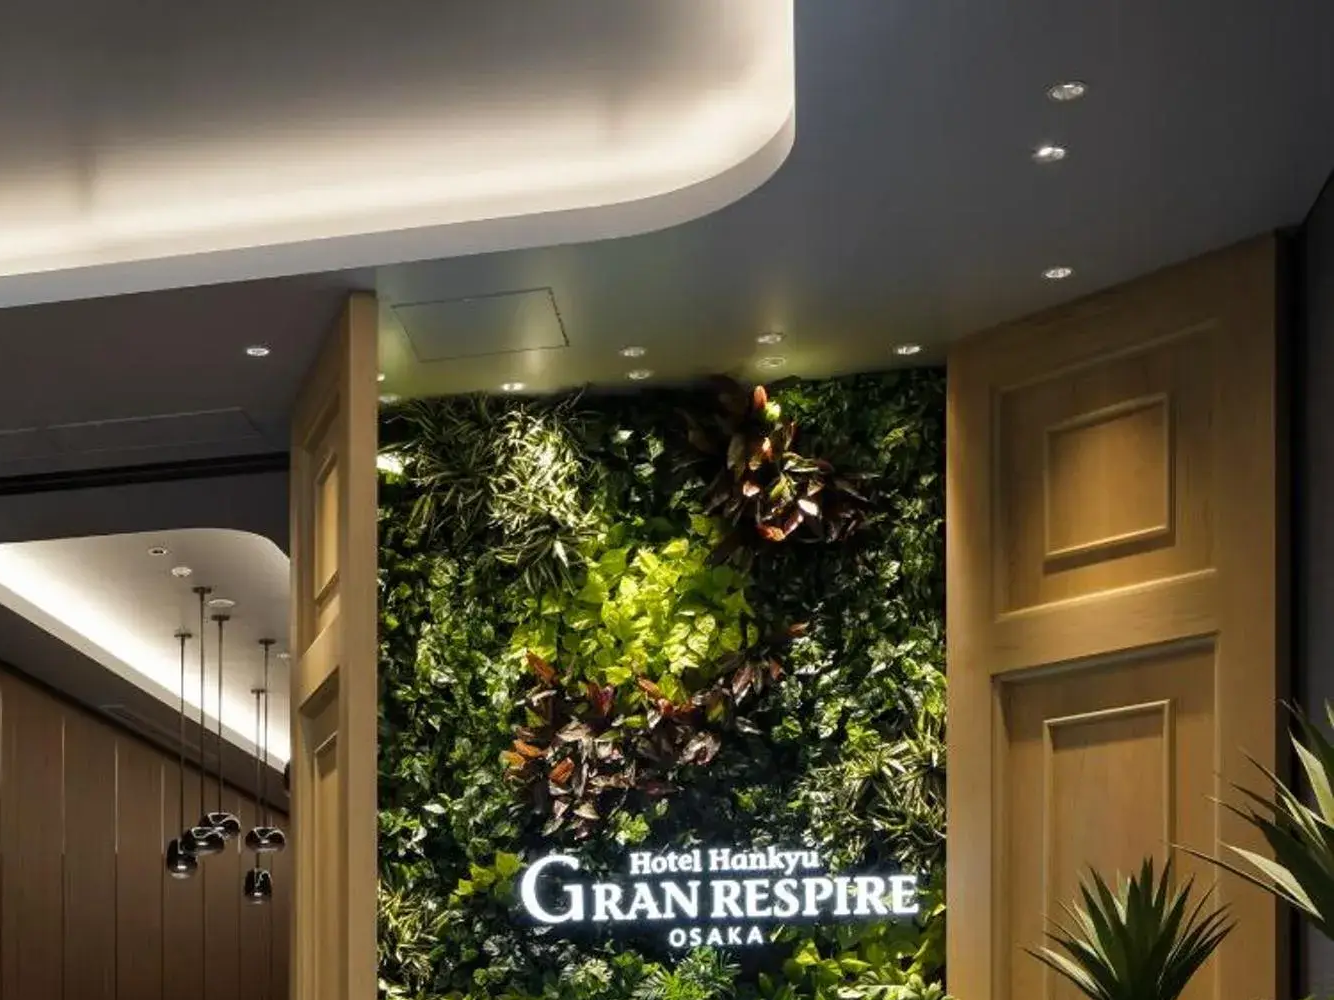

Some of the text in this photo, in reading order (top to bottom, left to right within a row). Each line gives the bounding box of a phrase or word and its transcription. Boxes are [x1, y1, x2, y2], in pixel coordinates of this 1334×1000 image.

[630, 848, 819, 875] Hotel Hankyu
[520, 855, 919, 923] GRAN RESPIRE
[668, 926, 764, 947] OSAKA
